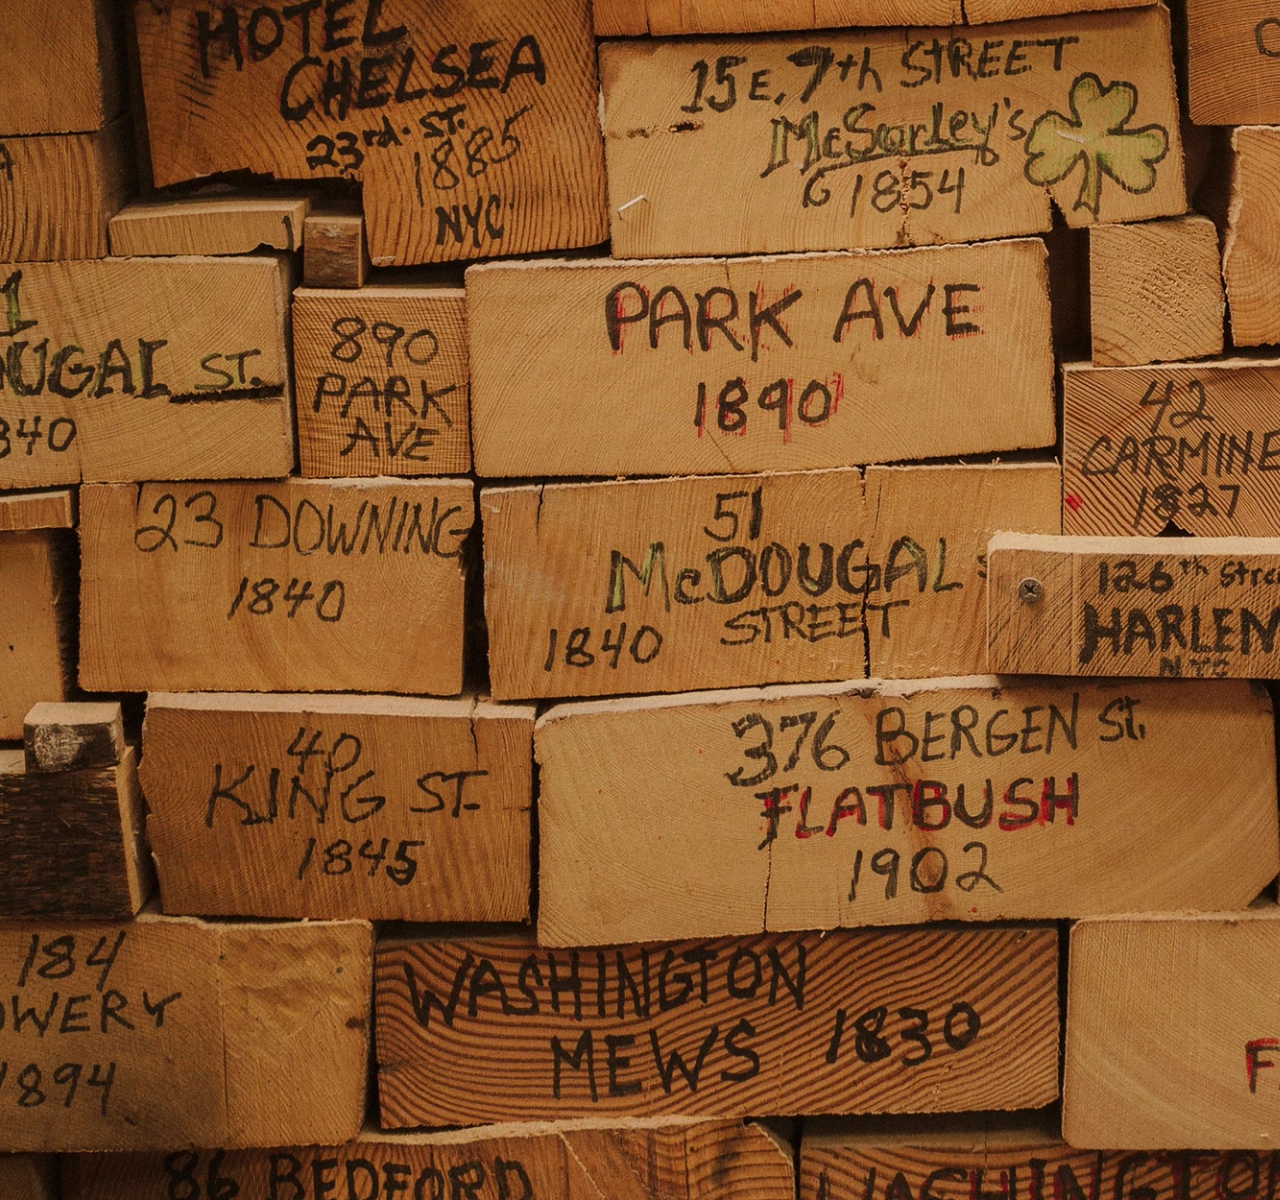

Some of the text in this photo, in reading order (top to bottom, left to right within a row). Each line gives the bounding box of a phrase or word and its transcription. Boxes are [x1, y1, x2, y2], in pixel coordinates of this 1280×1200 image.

[278, 34, 547, 124] CHELSEA
[680, 55, 749, 115] 15
[900, 35, 1081, 89] STREET
[413, 103, 535, 208] 1885
[329, 314, 439, 369] 890
[605, 275, 986, 364] PARK AVE
[311, 372, 470, 426] PARK
[695, 374, 844, 442] 1890
[1139, 378, 1214, 430] 42
[340, 414, 443, 462] AVE
[133, 490, 475, 558] 23 DOWNING
[703, 485, 764, 542] 51
[226, 575, 346, 624] 1840
[605, 536, 963, 616] McDOUGAL
[542, 600, 911, 673] 1840 STREET
[286, 726, 362, 776] 40
[724, 691, 1079, 788] 376 BERGEN
[205, 763, 387, 828] KING
[753, 771, 1081, 850] FLATBUSH
[298, 836, 426, 886] 1845
[848, 841, 1004, 903] 1902
[16, 930, 127, 992] 184
[403, 942, 809, 1030] WASHINGTON
[0, 988, 182, 1038] WERY
[550, 1001, 982, 1104] MEWS 1830
[161, 1149, 240, 1200] 86
